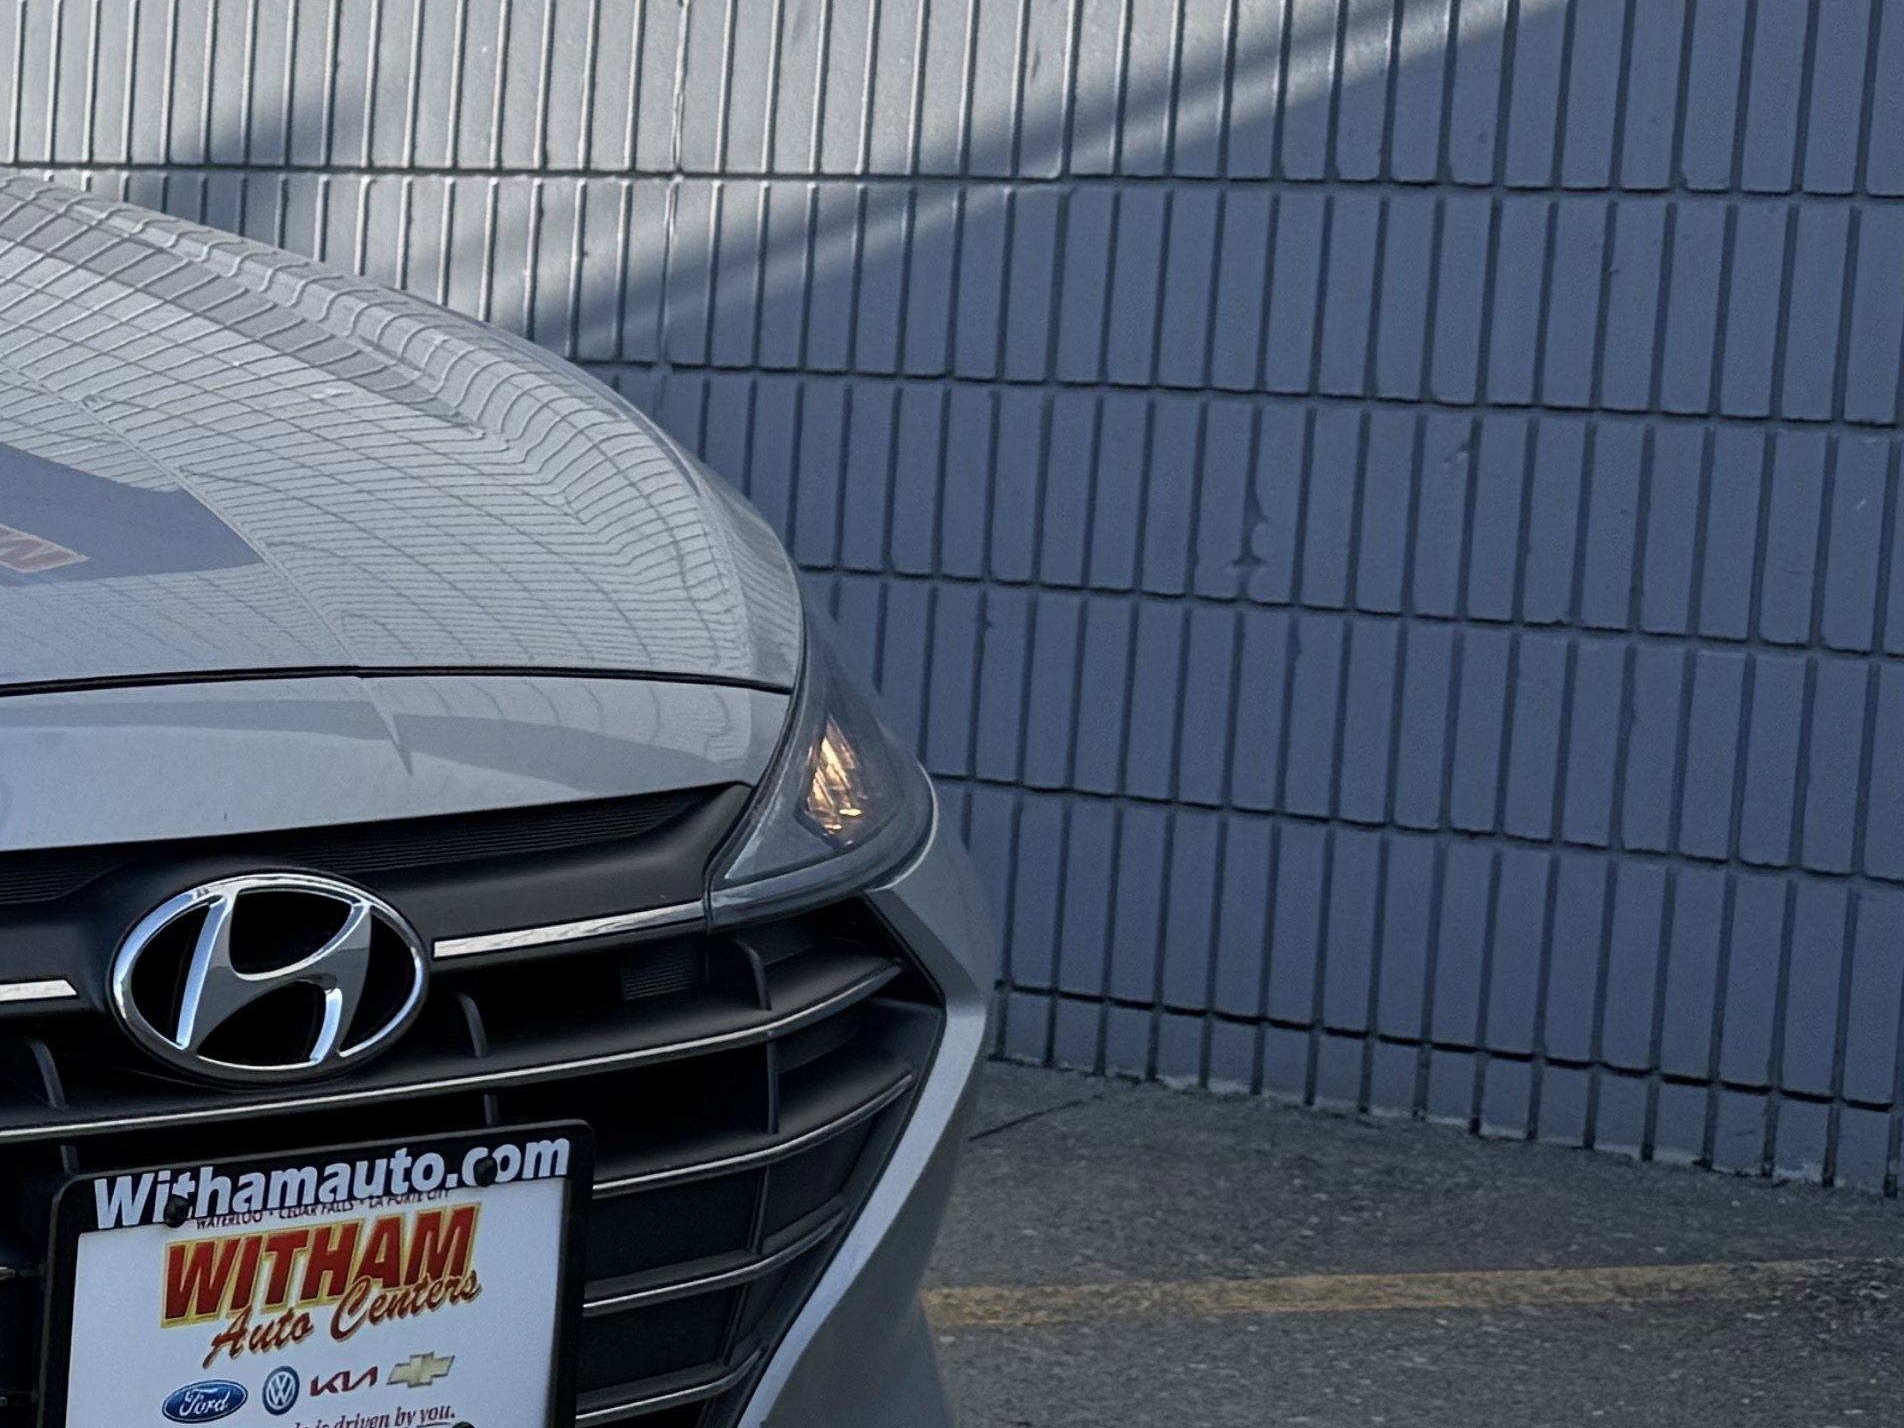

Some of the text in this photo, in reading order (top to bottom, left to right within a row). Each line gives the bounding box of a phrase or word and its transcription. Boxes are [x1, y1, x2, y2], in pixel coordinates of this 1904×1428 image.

[94, 1138, 571, 1230] Withamauto.com
[161, 1202, 481, 1329] WITHAM
[202, 1268, 482, 1370] Auto Centers
